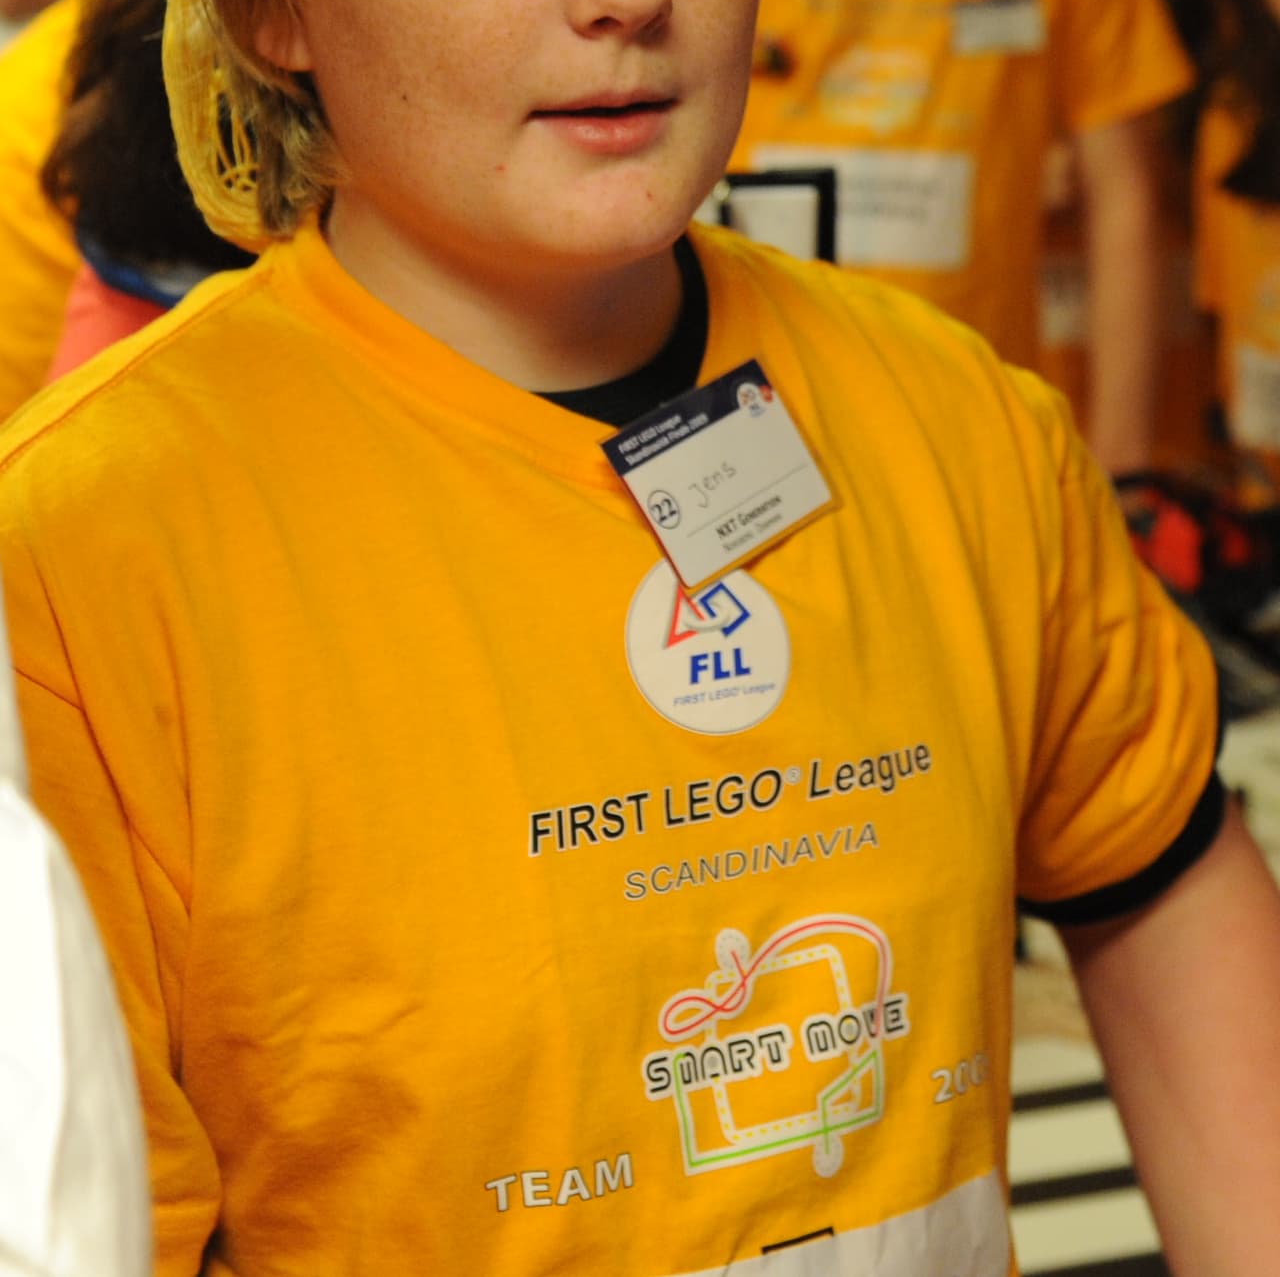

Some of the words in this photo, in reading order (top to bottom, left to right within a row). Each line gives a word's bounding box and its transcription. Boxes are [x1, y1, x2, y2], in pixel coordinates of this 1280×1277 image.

[650, 498, 677, 524] 22
[716, 518, 738, 539] NXT
[689, 647, 751, 685] FLL
[673, 691, 706, 707] FIRST
[527, 791, 650, 857] FIRST
[807, 742, 933, 802] League
[623, 822, 880, 900] SCANDINAVIA
[644, 1029, 787, 1095] SMART
[805, 997, 906, 1056] MOVE
[485, 1152, 635, 1213] TEAM
